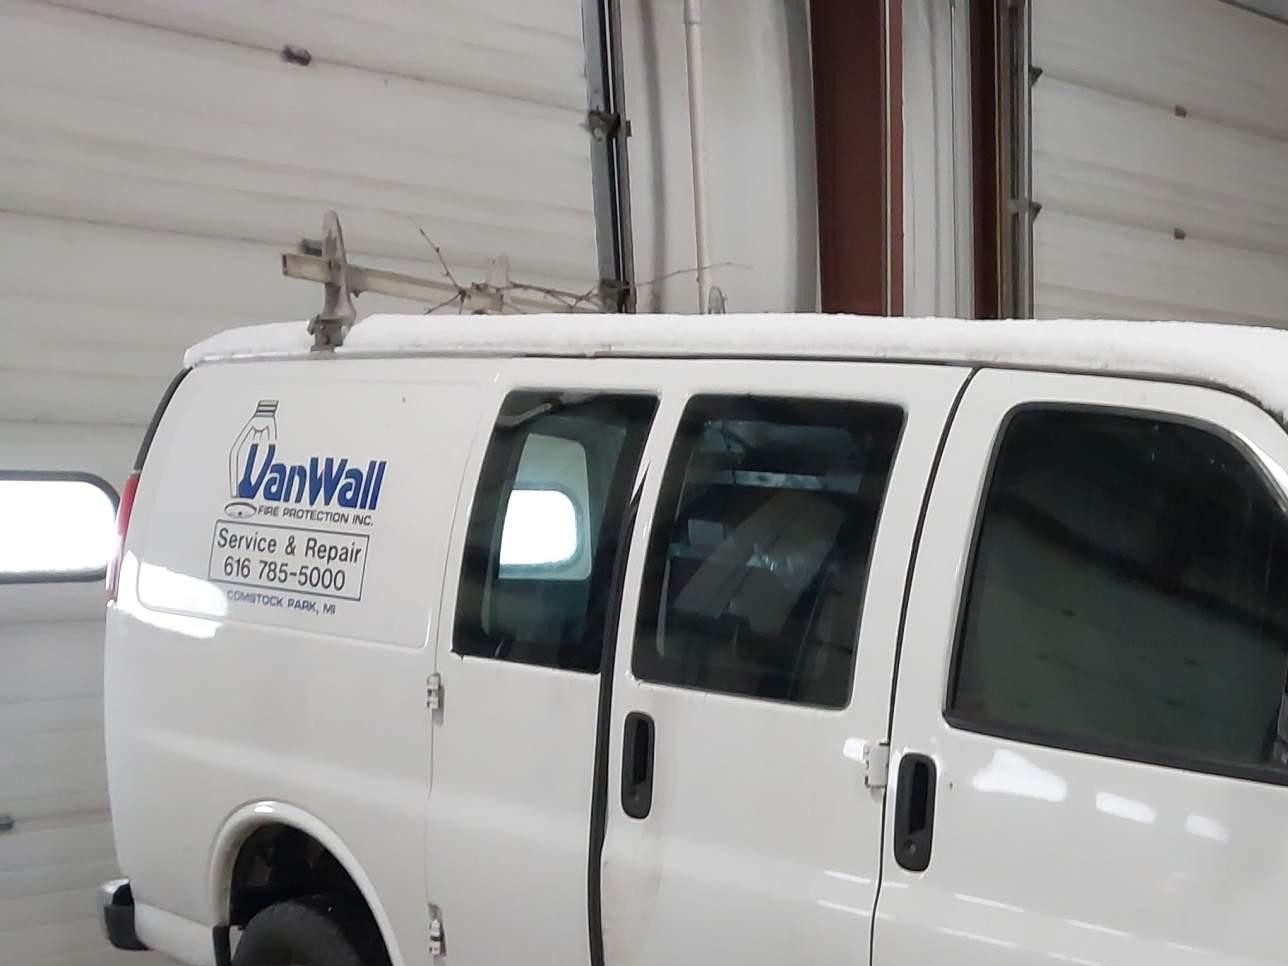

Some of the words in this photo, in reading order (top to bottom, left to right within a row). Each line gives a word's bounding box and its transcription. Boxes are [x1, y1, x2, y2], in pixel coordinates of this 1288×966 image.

[238, 443, 387, 510] VanWall
[257, 505, 279, 517] FIRE
[282, 507, 348, 523] PROTECTION
[352, 514, 374, 526] INC.
[217, 527, 277, 554] Service
[285, 535, 297, 556] &
[304, 537, 362, 564] Repair
[224, 555, 251, 578] 616
[258, 560, 346, 591] 785-5000
[226, 590, 283, 608] COMSTOCK
[287, 599, 319, 615] PARK,
[323, 604, 336, 615] MI
